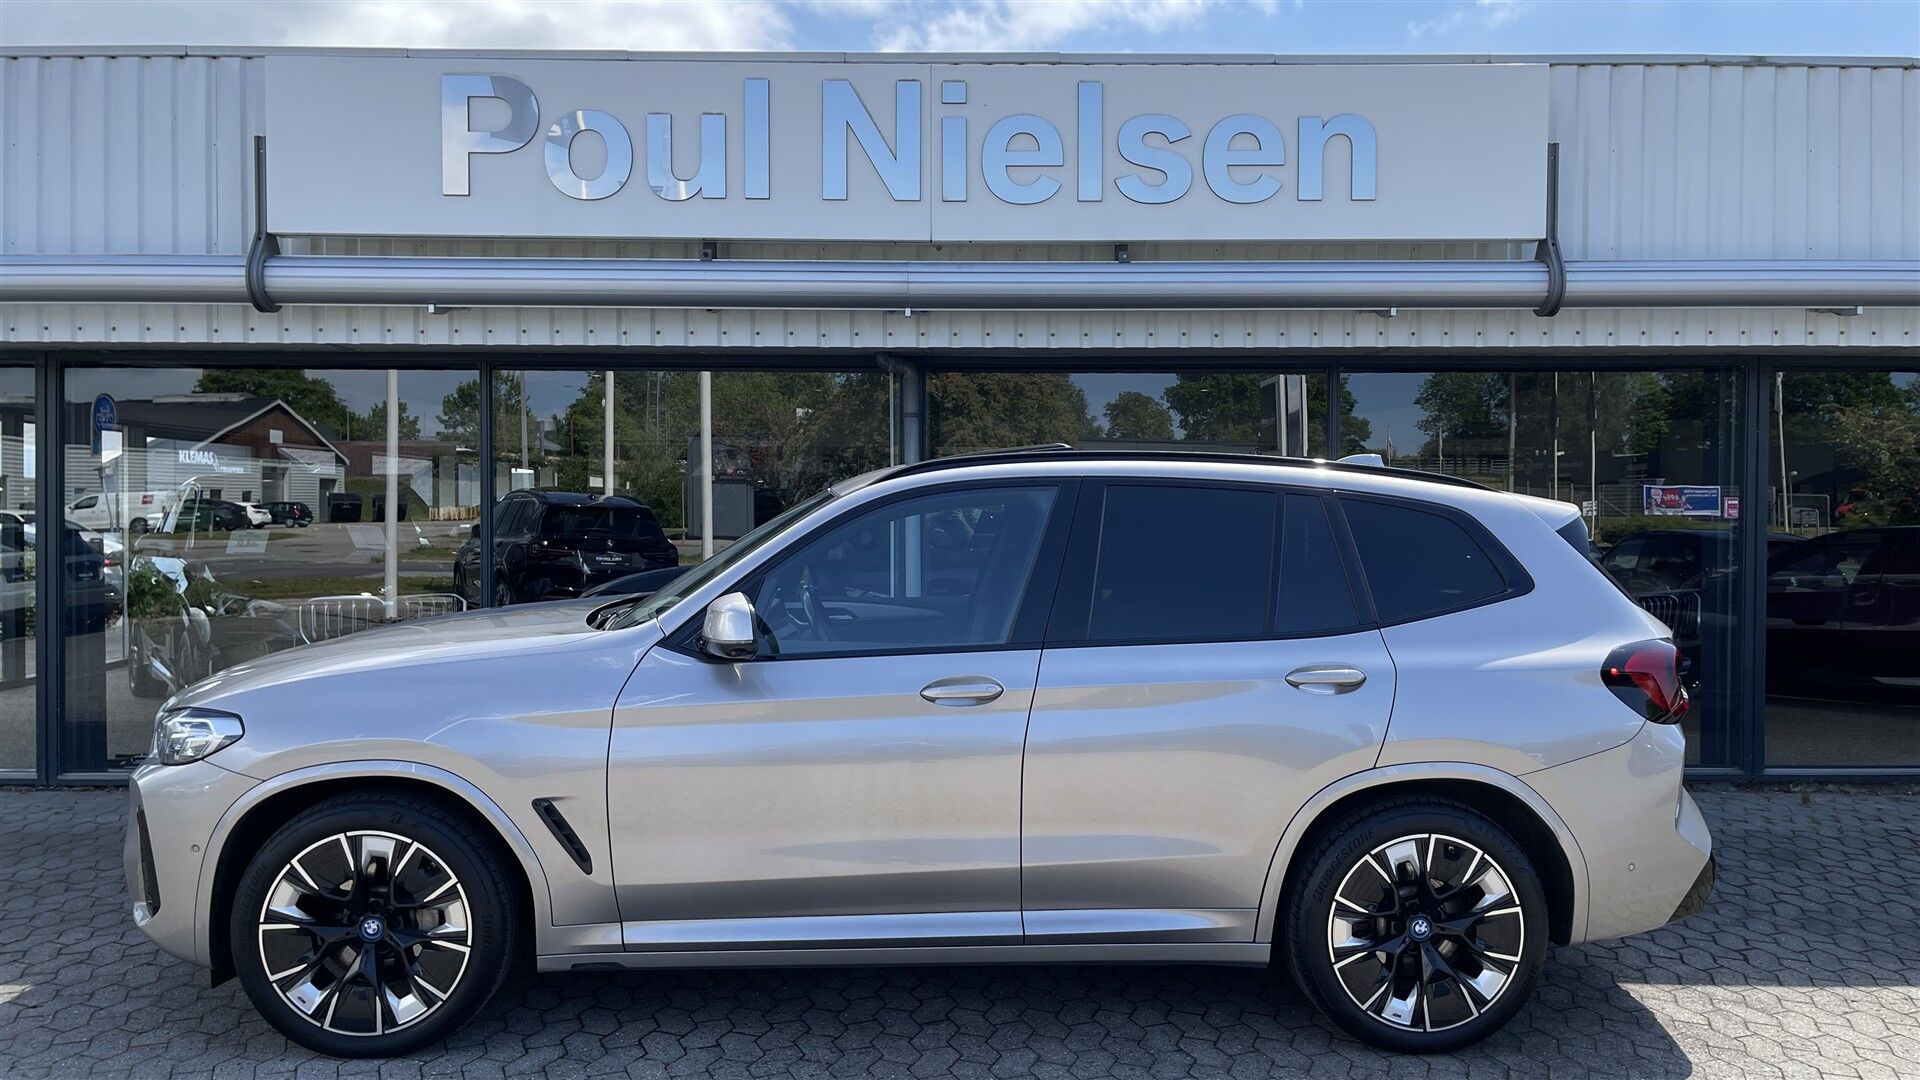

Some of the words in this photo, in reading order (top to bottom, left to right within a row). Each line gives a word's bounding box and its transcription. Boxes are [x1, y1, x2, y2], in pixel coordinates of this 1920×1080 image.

[441, 73, 770, 202] Poul
[821, 78, 1378, 205] Nielsen
[179, 449, 214, 465] KLEMAS
